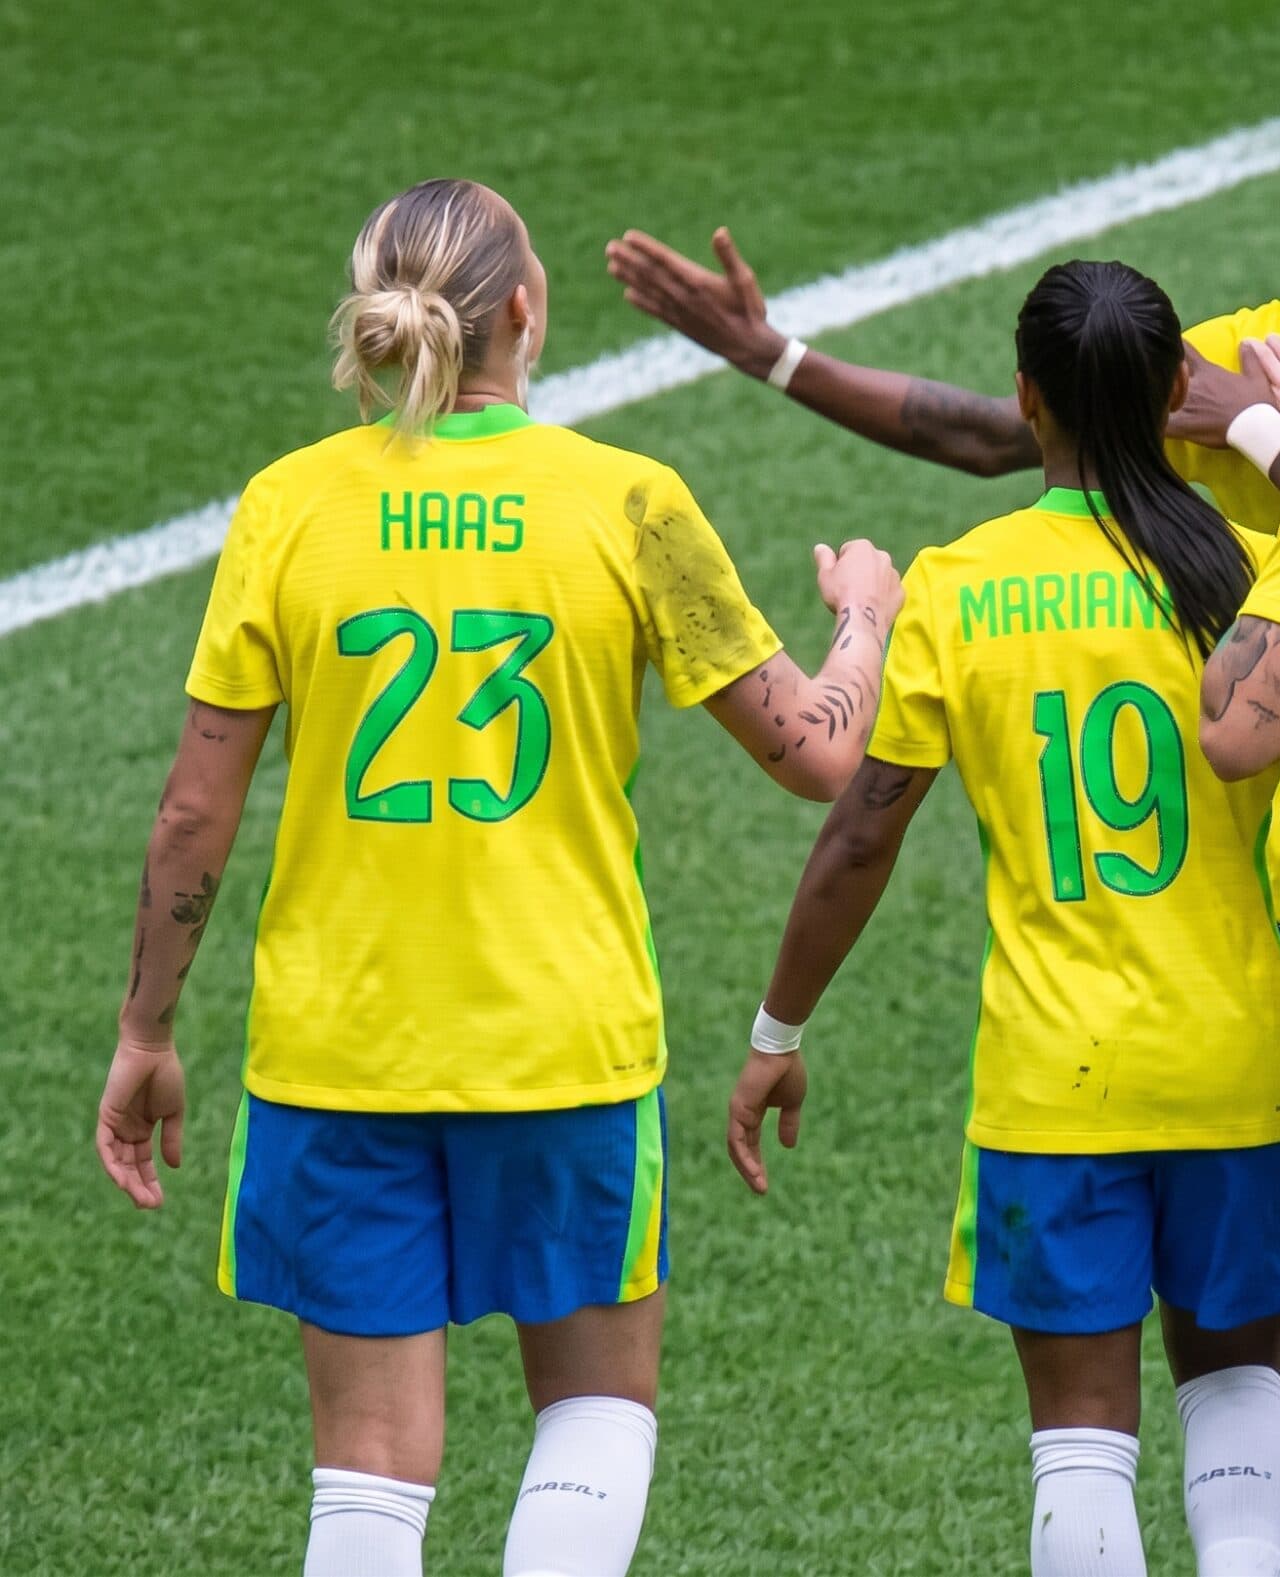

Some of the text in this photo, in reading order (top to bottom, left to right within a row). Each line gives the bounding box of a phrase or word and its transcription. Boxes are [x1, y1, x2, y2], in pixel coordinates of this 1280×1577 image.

[379, 491, 525, 552] HAAS
[336, 606, 554, 824] 23
[1033, 681, 1190, 902] 19
